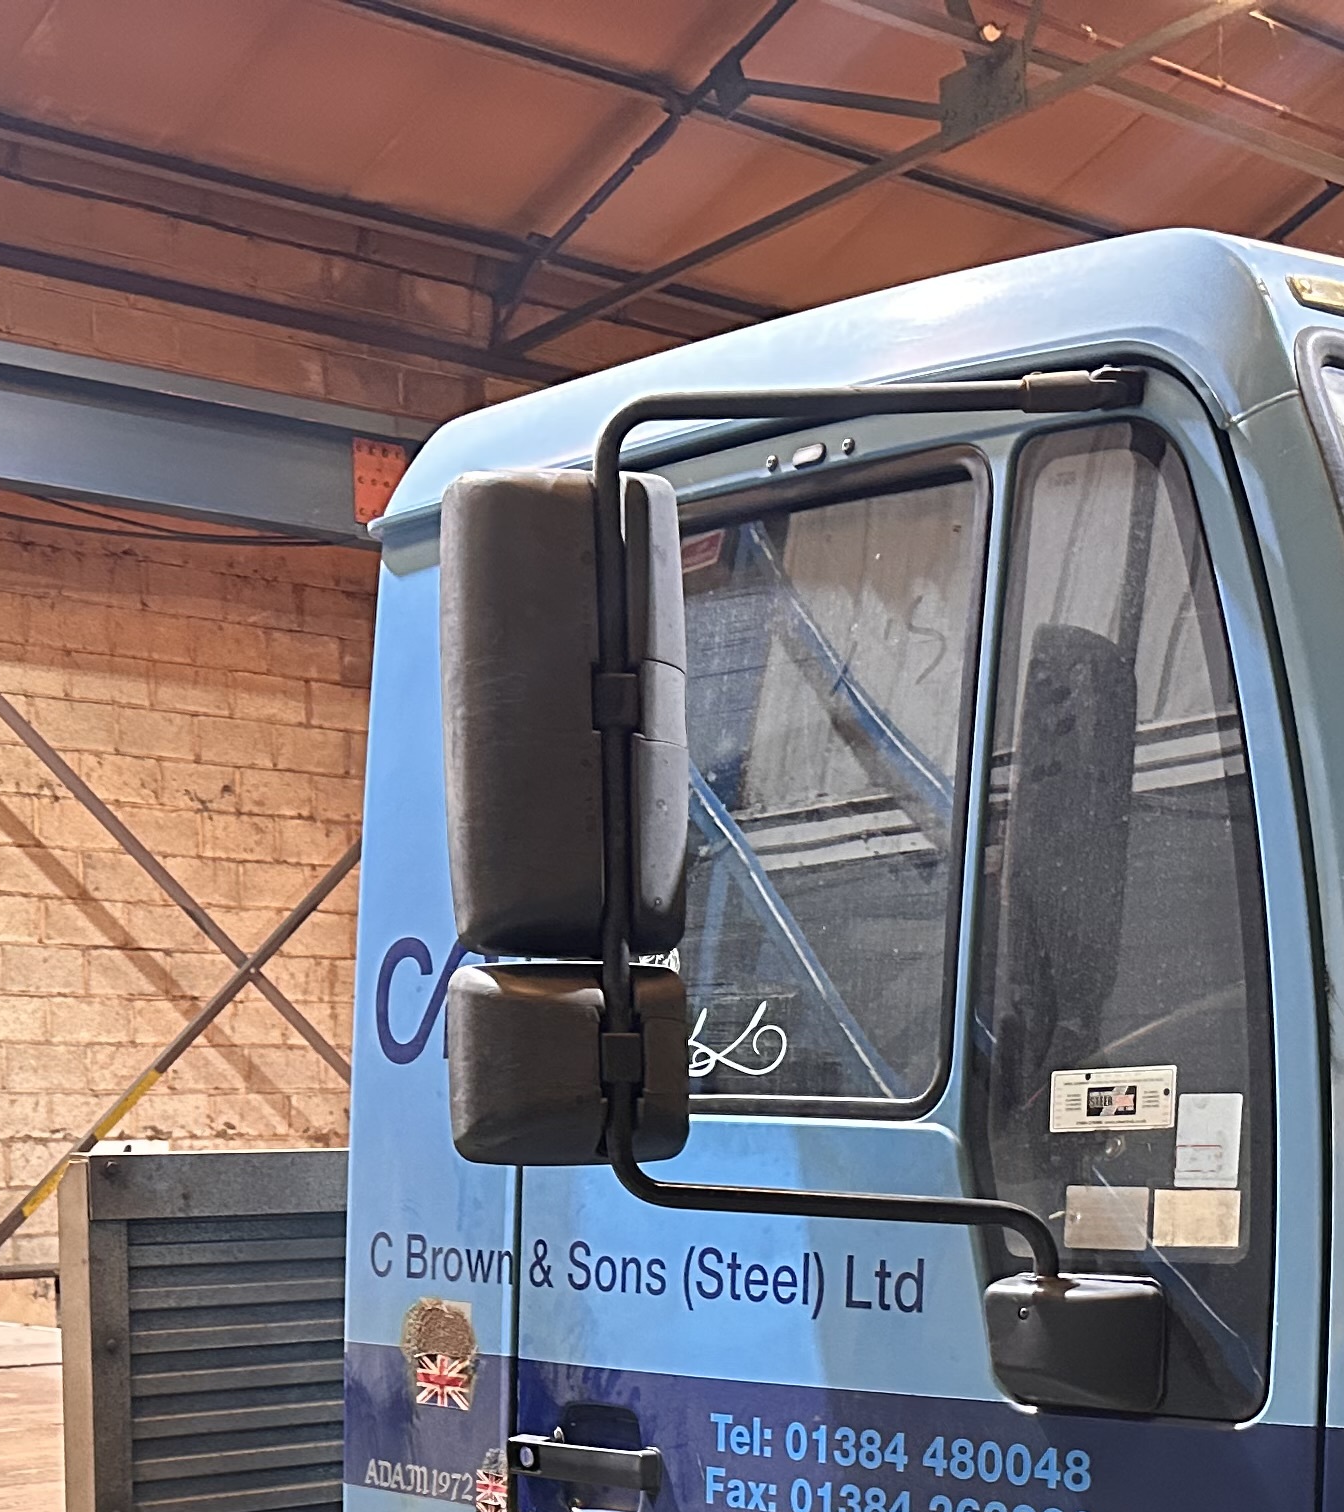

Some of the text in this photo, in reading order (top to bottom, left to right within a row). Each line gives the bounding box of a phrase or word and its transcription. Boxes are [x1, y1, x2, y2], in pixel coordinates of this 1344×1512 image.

[370, 1231, 925, 1320] C Brown & Sons (Steel) Ltd
[710, 1412, 1092, 1493] Tel: 01384 480048
